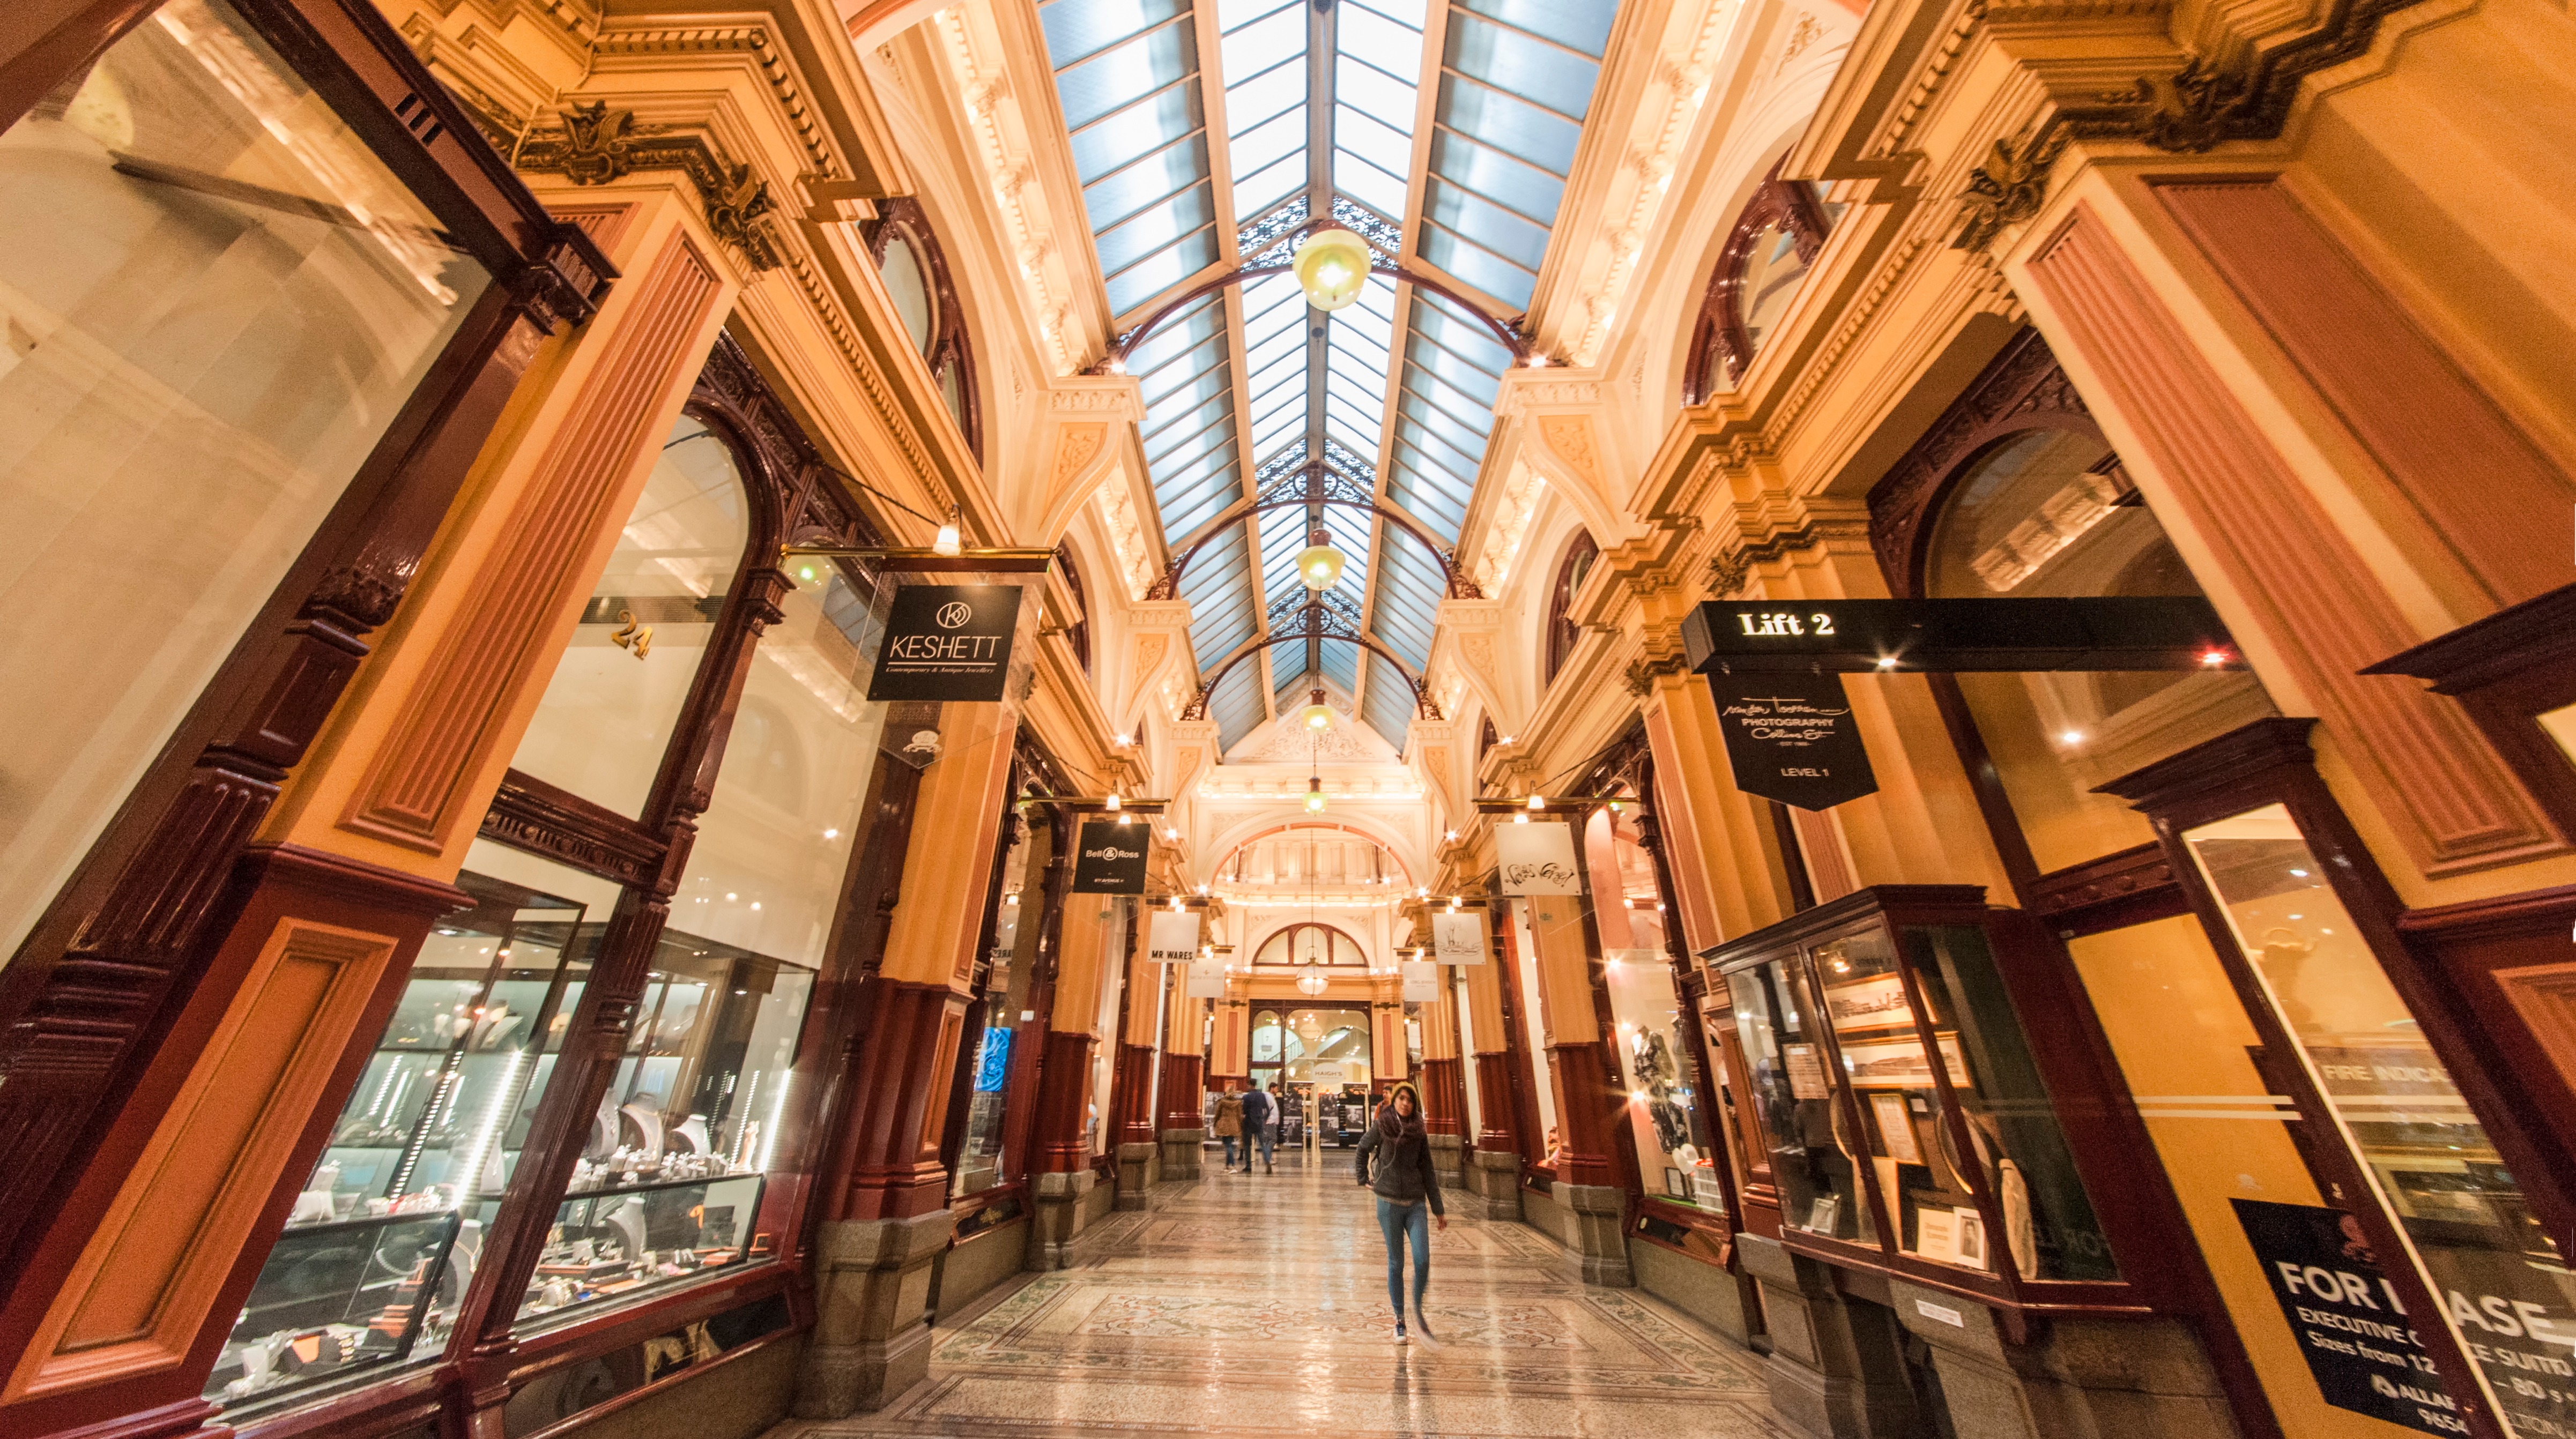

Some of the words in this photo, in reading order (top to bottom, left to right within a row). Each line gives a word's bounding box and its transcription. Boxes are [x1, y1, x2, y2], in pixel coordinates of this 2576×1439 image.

[611, 609, 653, 661] 24
[1737, 613, 1805, 636] Lift
[1811, 614, 1836, 635] 2
[889, 636, 1002, 659] KESHETT
[1780, 768, 1822, 777] LEVEL
[1822, 768, 1830, 777] 1
[1118, 850, 1139, 858] Ross
[1152, 950, 1163, 958] MR
[1167, 951, 1193, 960] WARES
[2321, 1064, 2373, 1080] FIRE
[2275, 1261, 2381, 1310] FOR
[2296, 1306, 2409, 1344] EXECUTIVE
[2307, 1330, 2358, 1355] Sizes
[2356, 1340, 2408, 1367] from
[2511, 1376, 2547, 1400] 80
